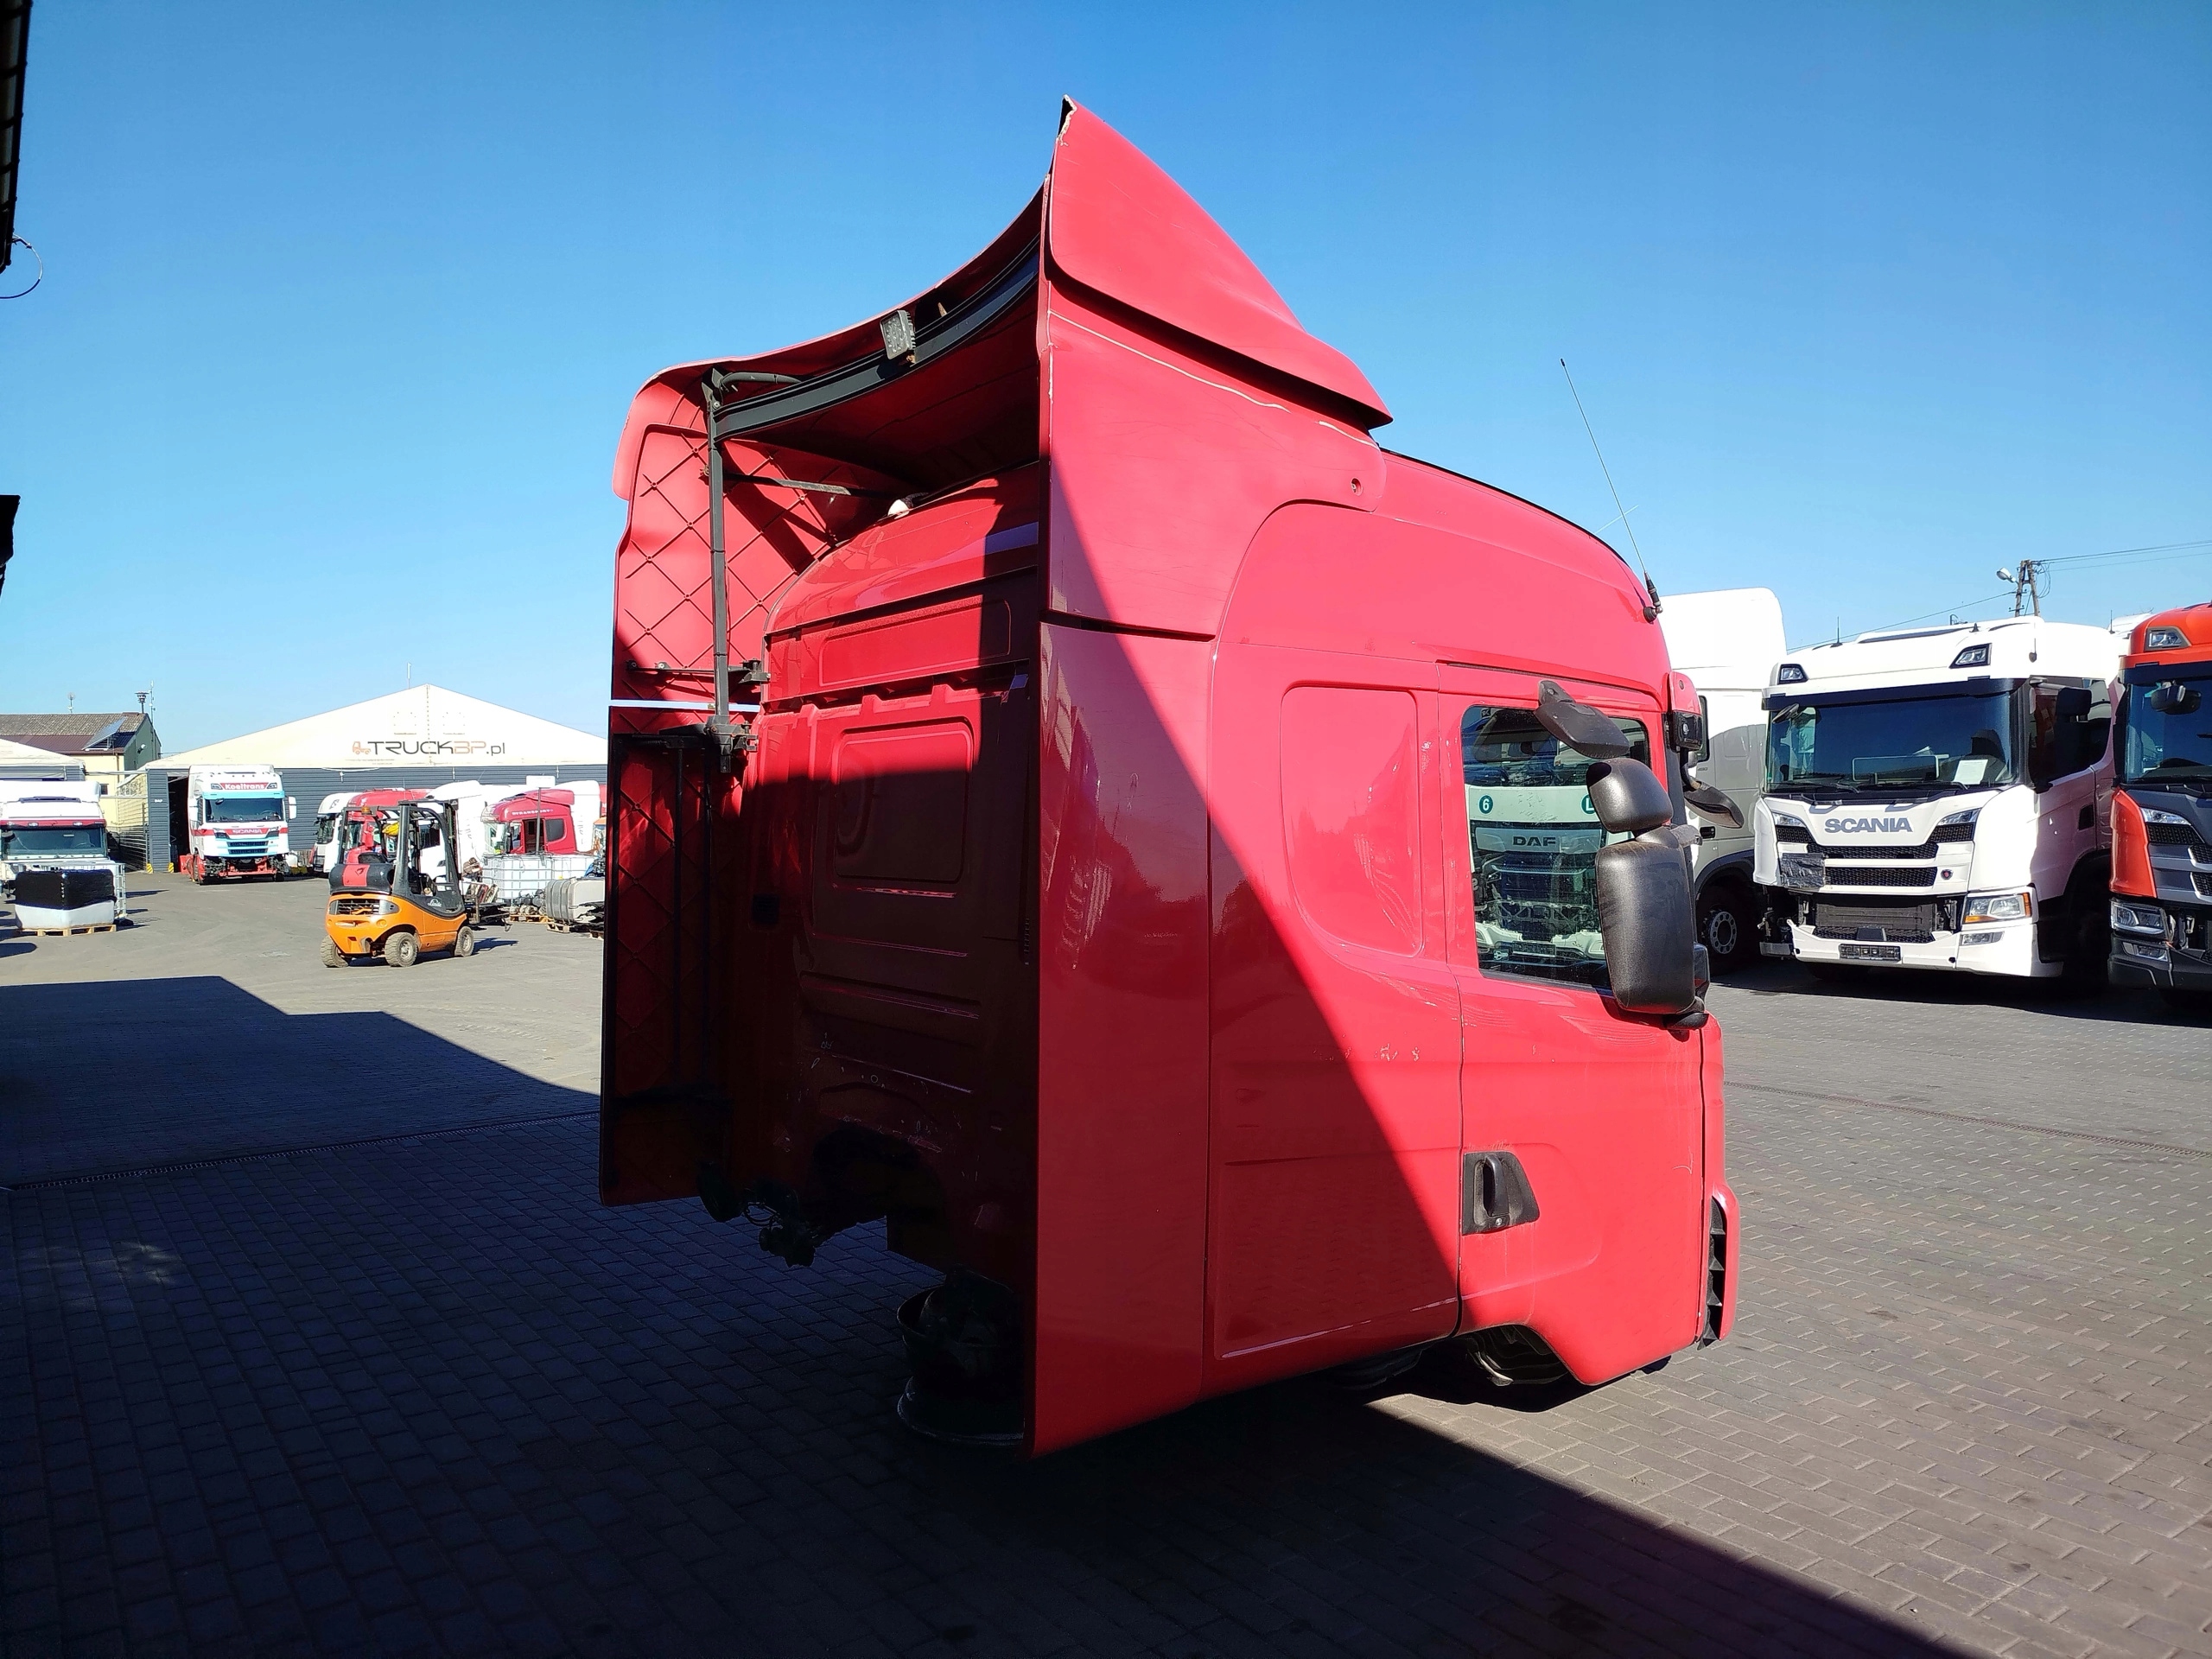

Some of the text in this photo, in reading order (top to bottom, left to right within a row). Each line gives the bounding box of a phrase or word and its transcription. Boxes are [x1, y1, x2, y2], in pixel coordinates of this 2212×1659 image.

[367, 741, 505, 756] TRUCKBP.pl
[1483, 798, 1490, 810] 6
[1824, 817, 1913, 834] SCANIA
[1512, 836, 1556, 847] DAF
